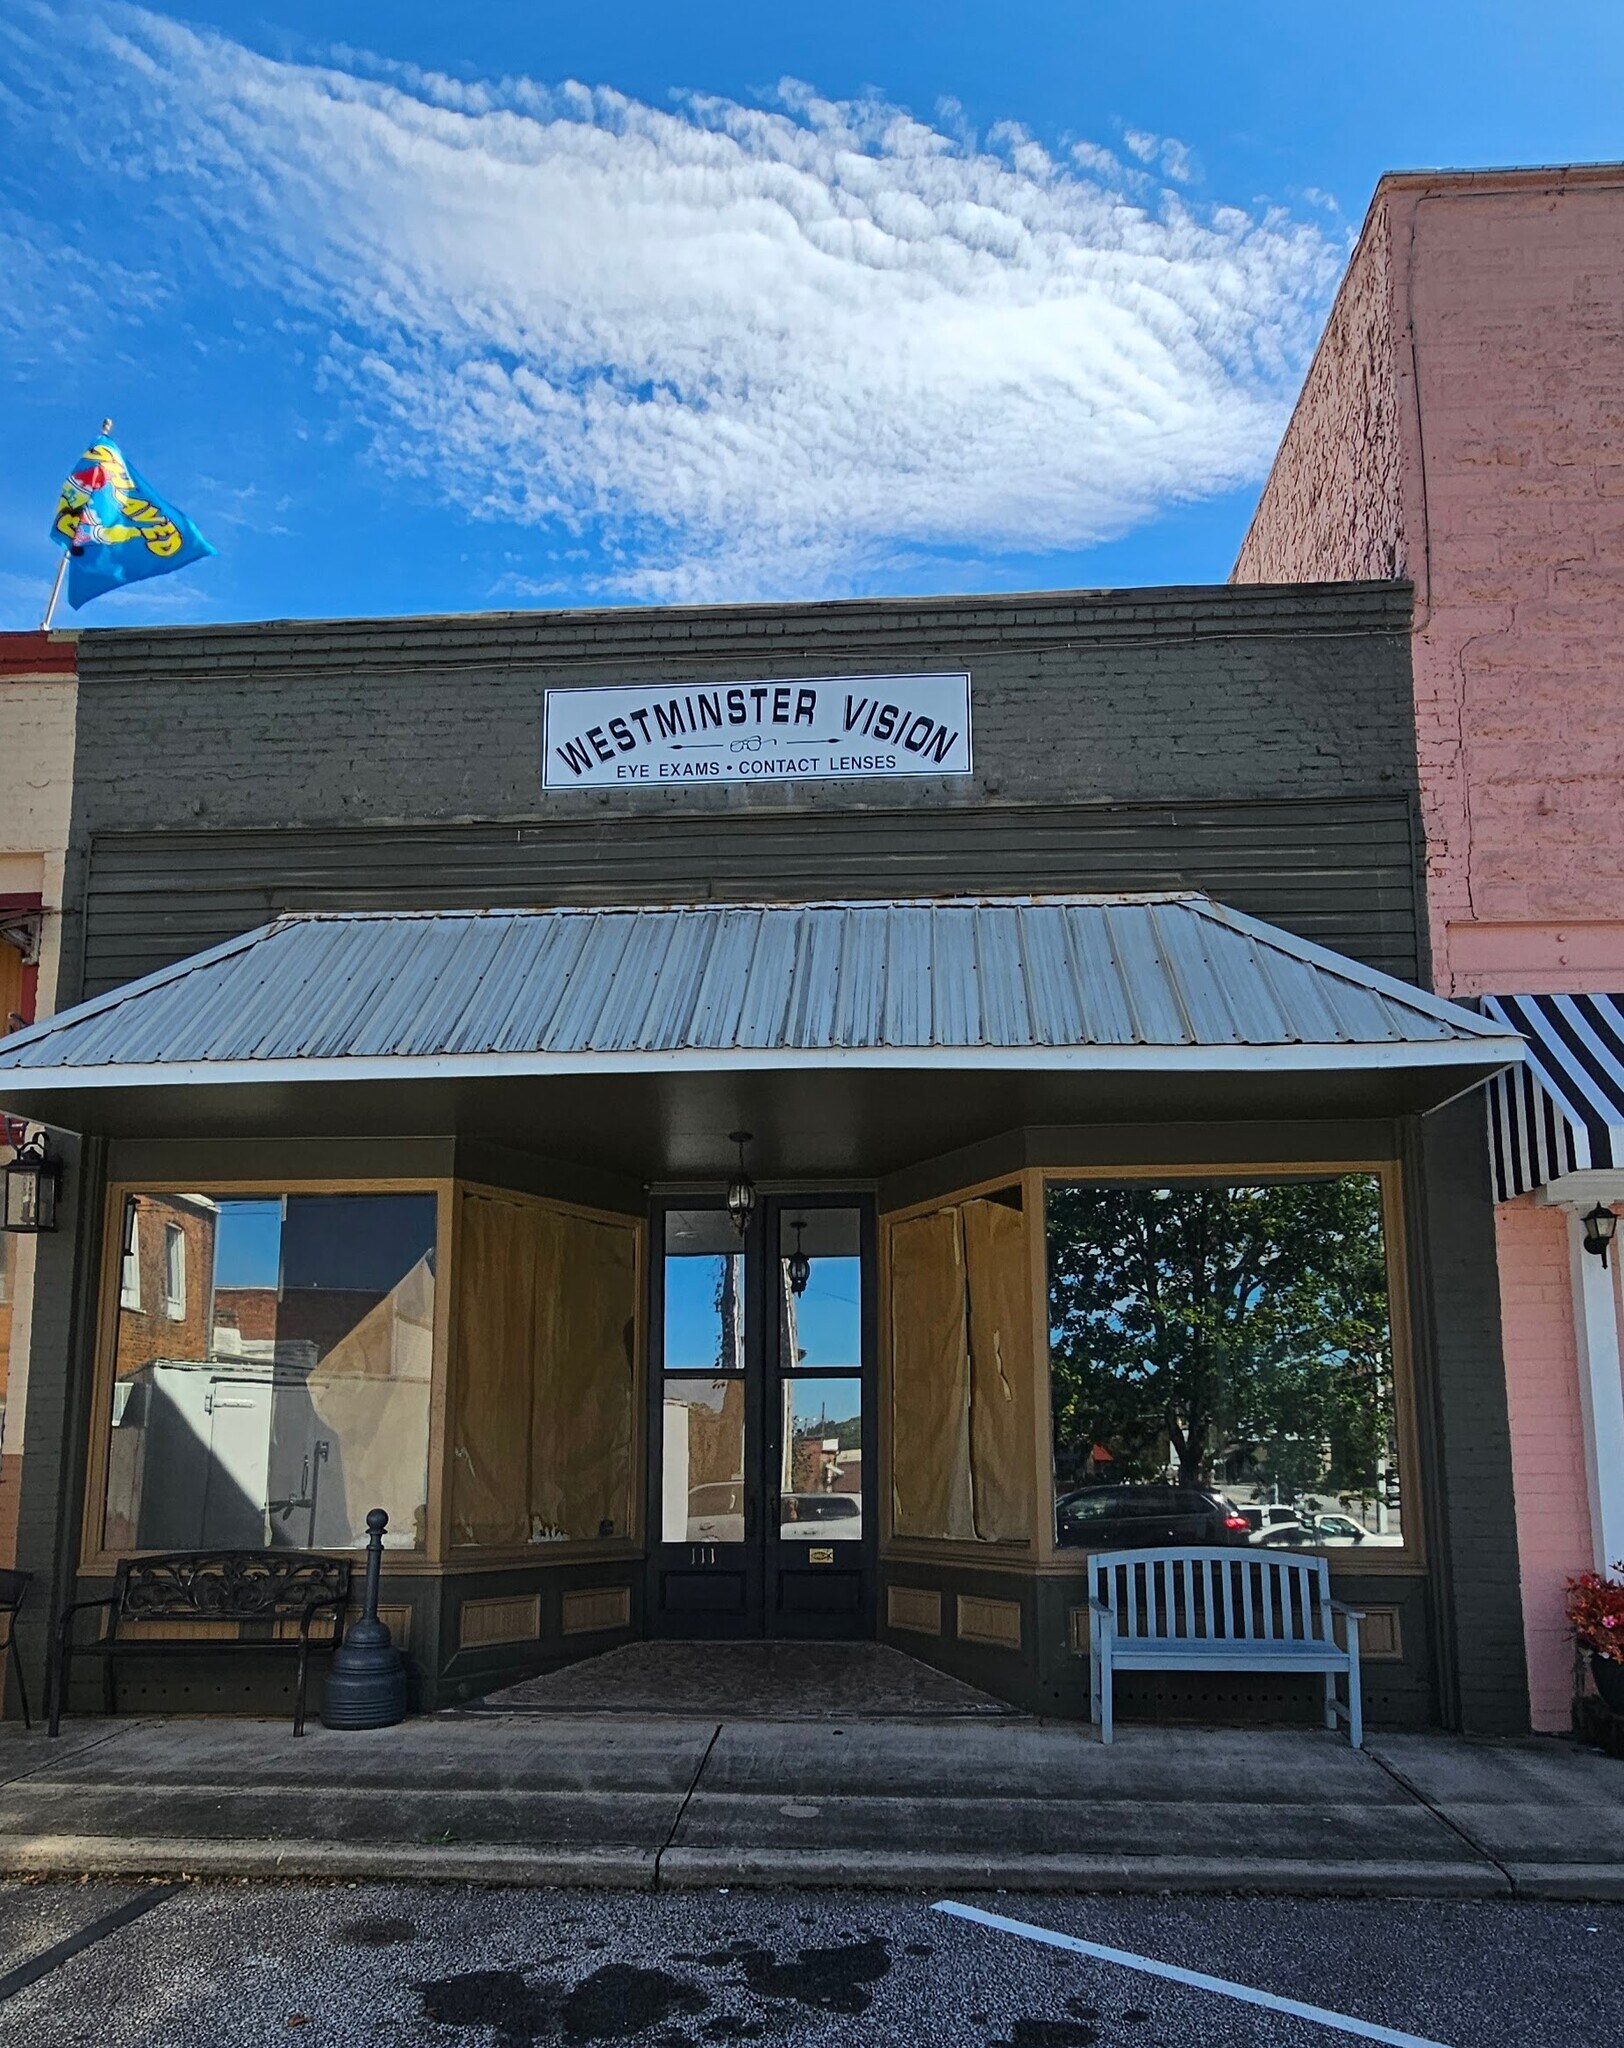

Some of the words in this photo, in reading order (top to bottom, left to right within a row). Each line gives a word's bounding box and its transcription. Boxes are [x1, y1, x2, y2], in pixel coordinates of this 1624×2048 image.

[82, 444, 184, 558] SHAVED
[556, 687, 817, 776] WESTMINSTER
[843, 695, 959, 764] VISION
[617, 764, 650, 779] EYE
[659, 761, 720, 777] EXAMS
[738, 757, 820, 775] CONTACT
[830, 755, 896, 771] LENSES
[691, 1547, 715, 1565] 111
